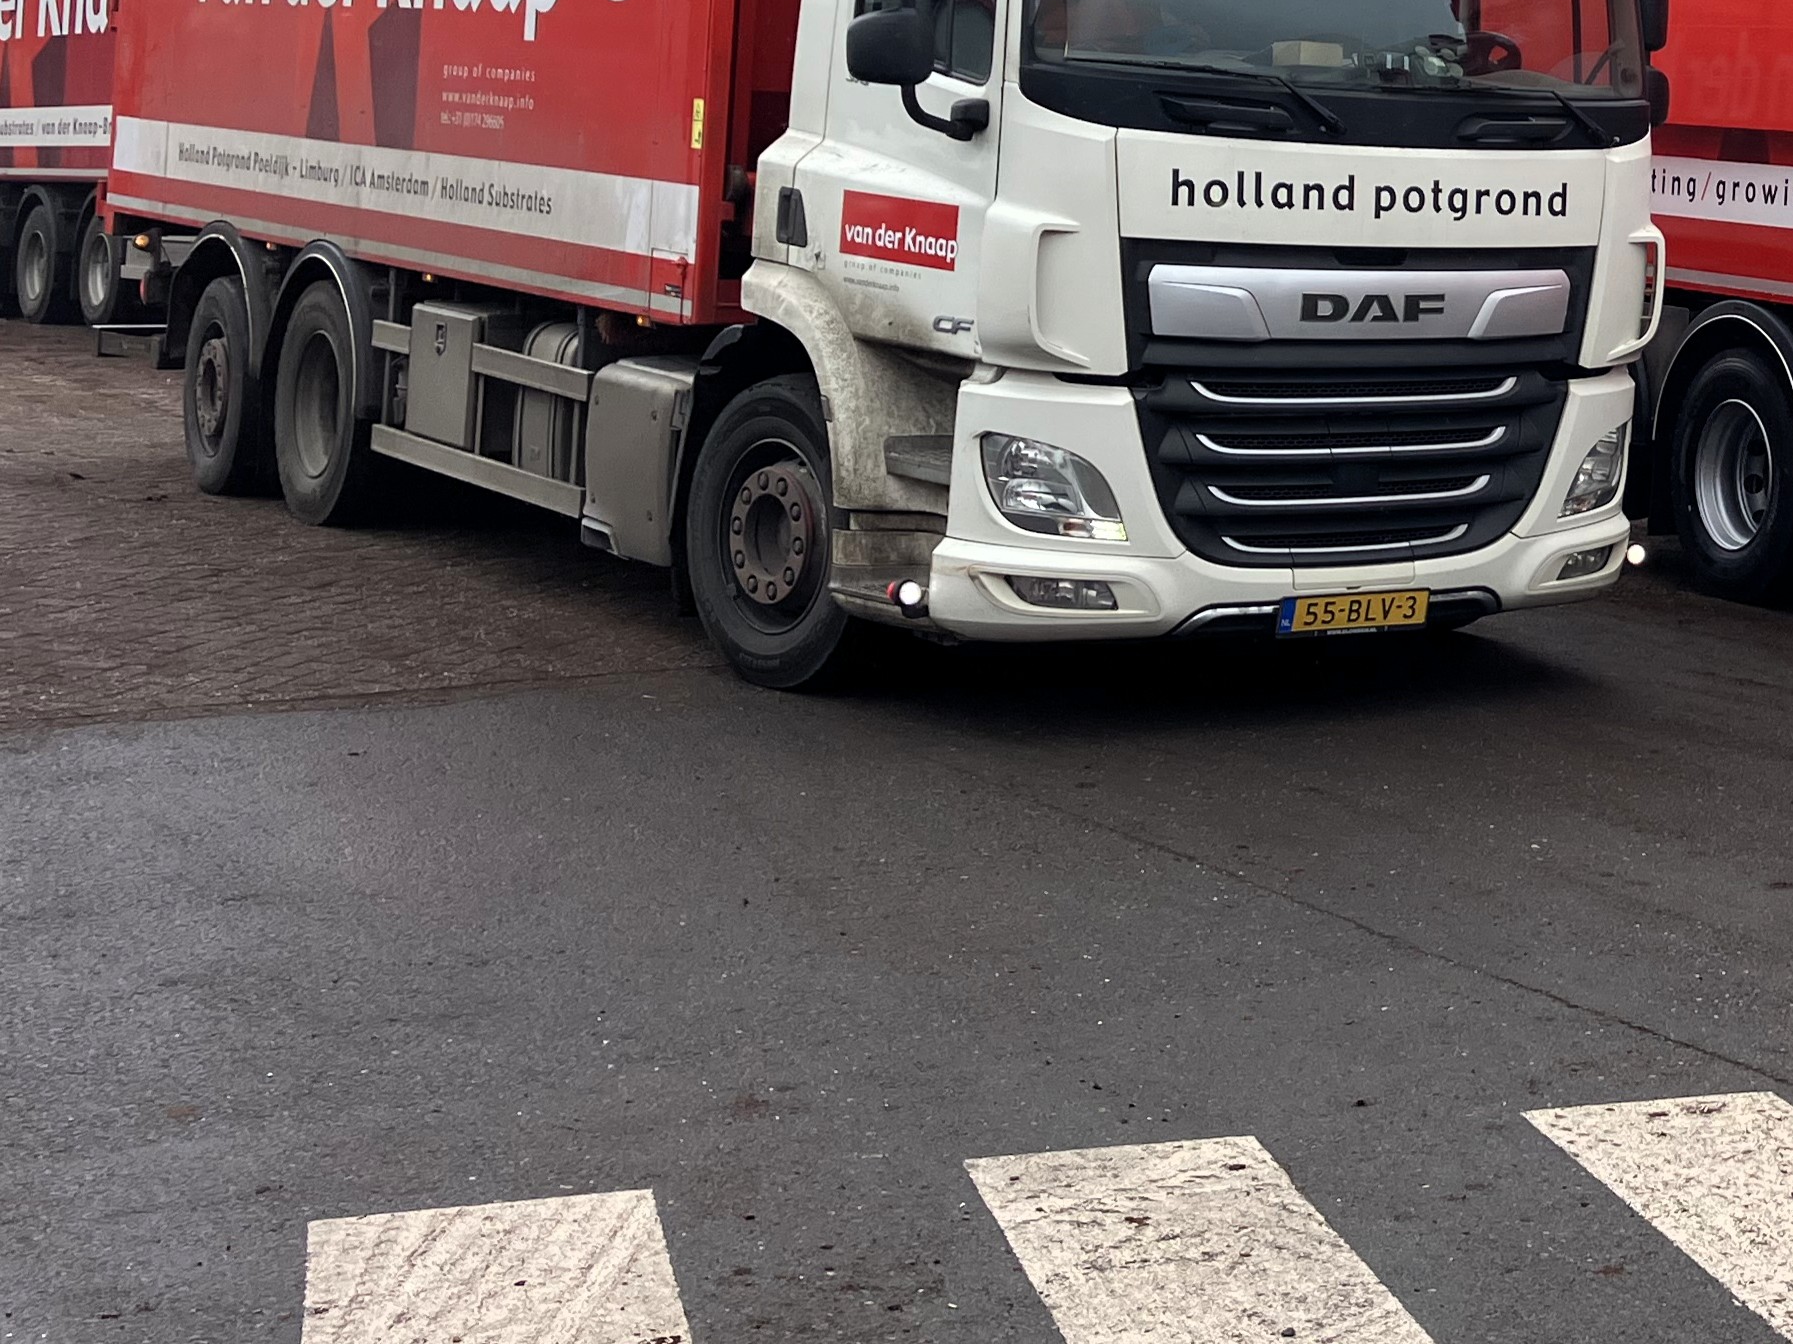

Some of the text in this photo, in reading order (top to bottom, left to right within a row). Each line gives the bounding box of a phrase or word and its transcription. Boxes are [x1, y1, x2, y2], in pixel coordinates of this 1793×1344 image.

[443, 63, 535, 83] group of companies
[442, 90, 534, 111] www.vanderknaap.info
[178, 142, 210, 166] Holland
[211, 146, 251, 172] Potgrond
[253, 151, 289, 179] Poeldijk
[300, 158, 339, 188] Limburg
[350, 164, 367, 188] ICA
[369, 169, 429, 197] Amsterdam
[440, 177, 485, 205] Holland
[487, 183, 552, 215] Substrates
[1171, 168, 1568, 221] holland potgrond
[845, 223, 958, 263] van der Knaap
[844, 260, 865, 271] group
[868, 263, 877, 272] of
[1300, 293, 1445, 323] DAF
[933, 315, 974, 335] CF
[1281, 596, 1417, 627] NL 55-BLV-3
